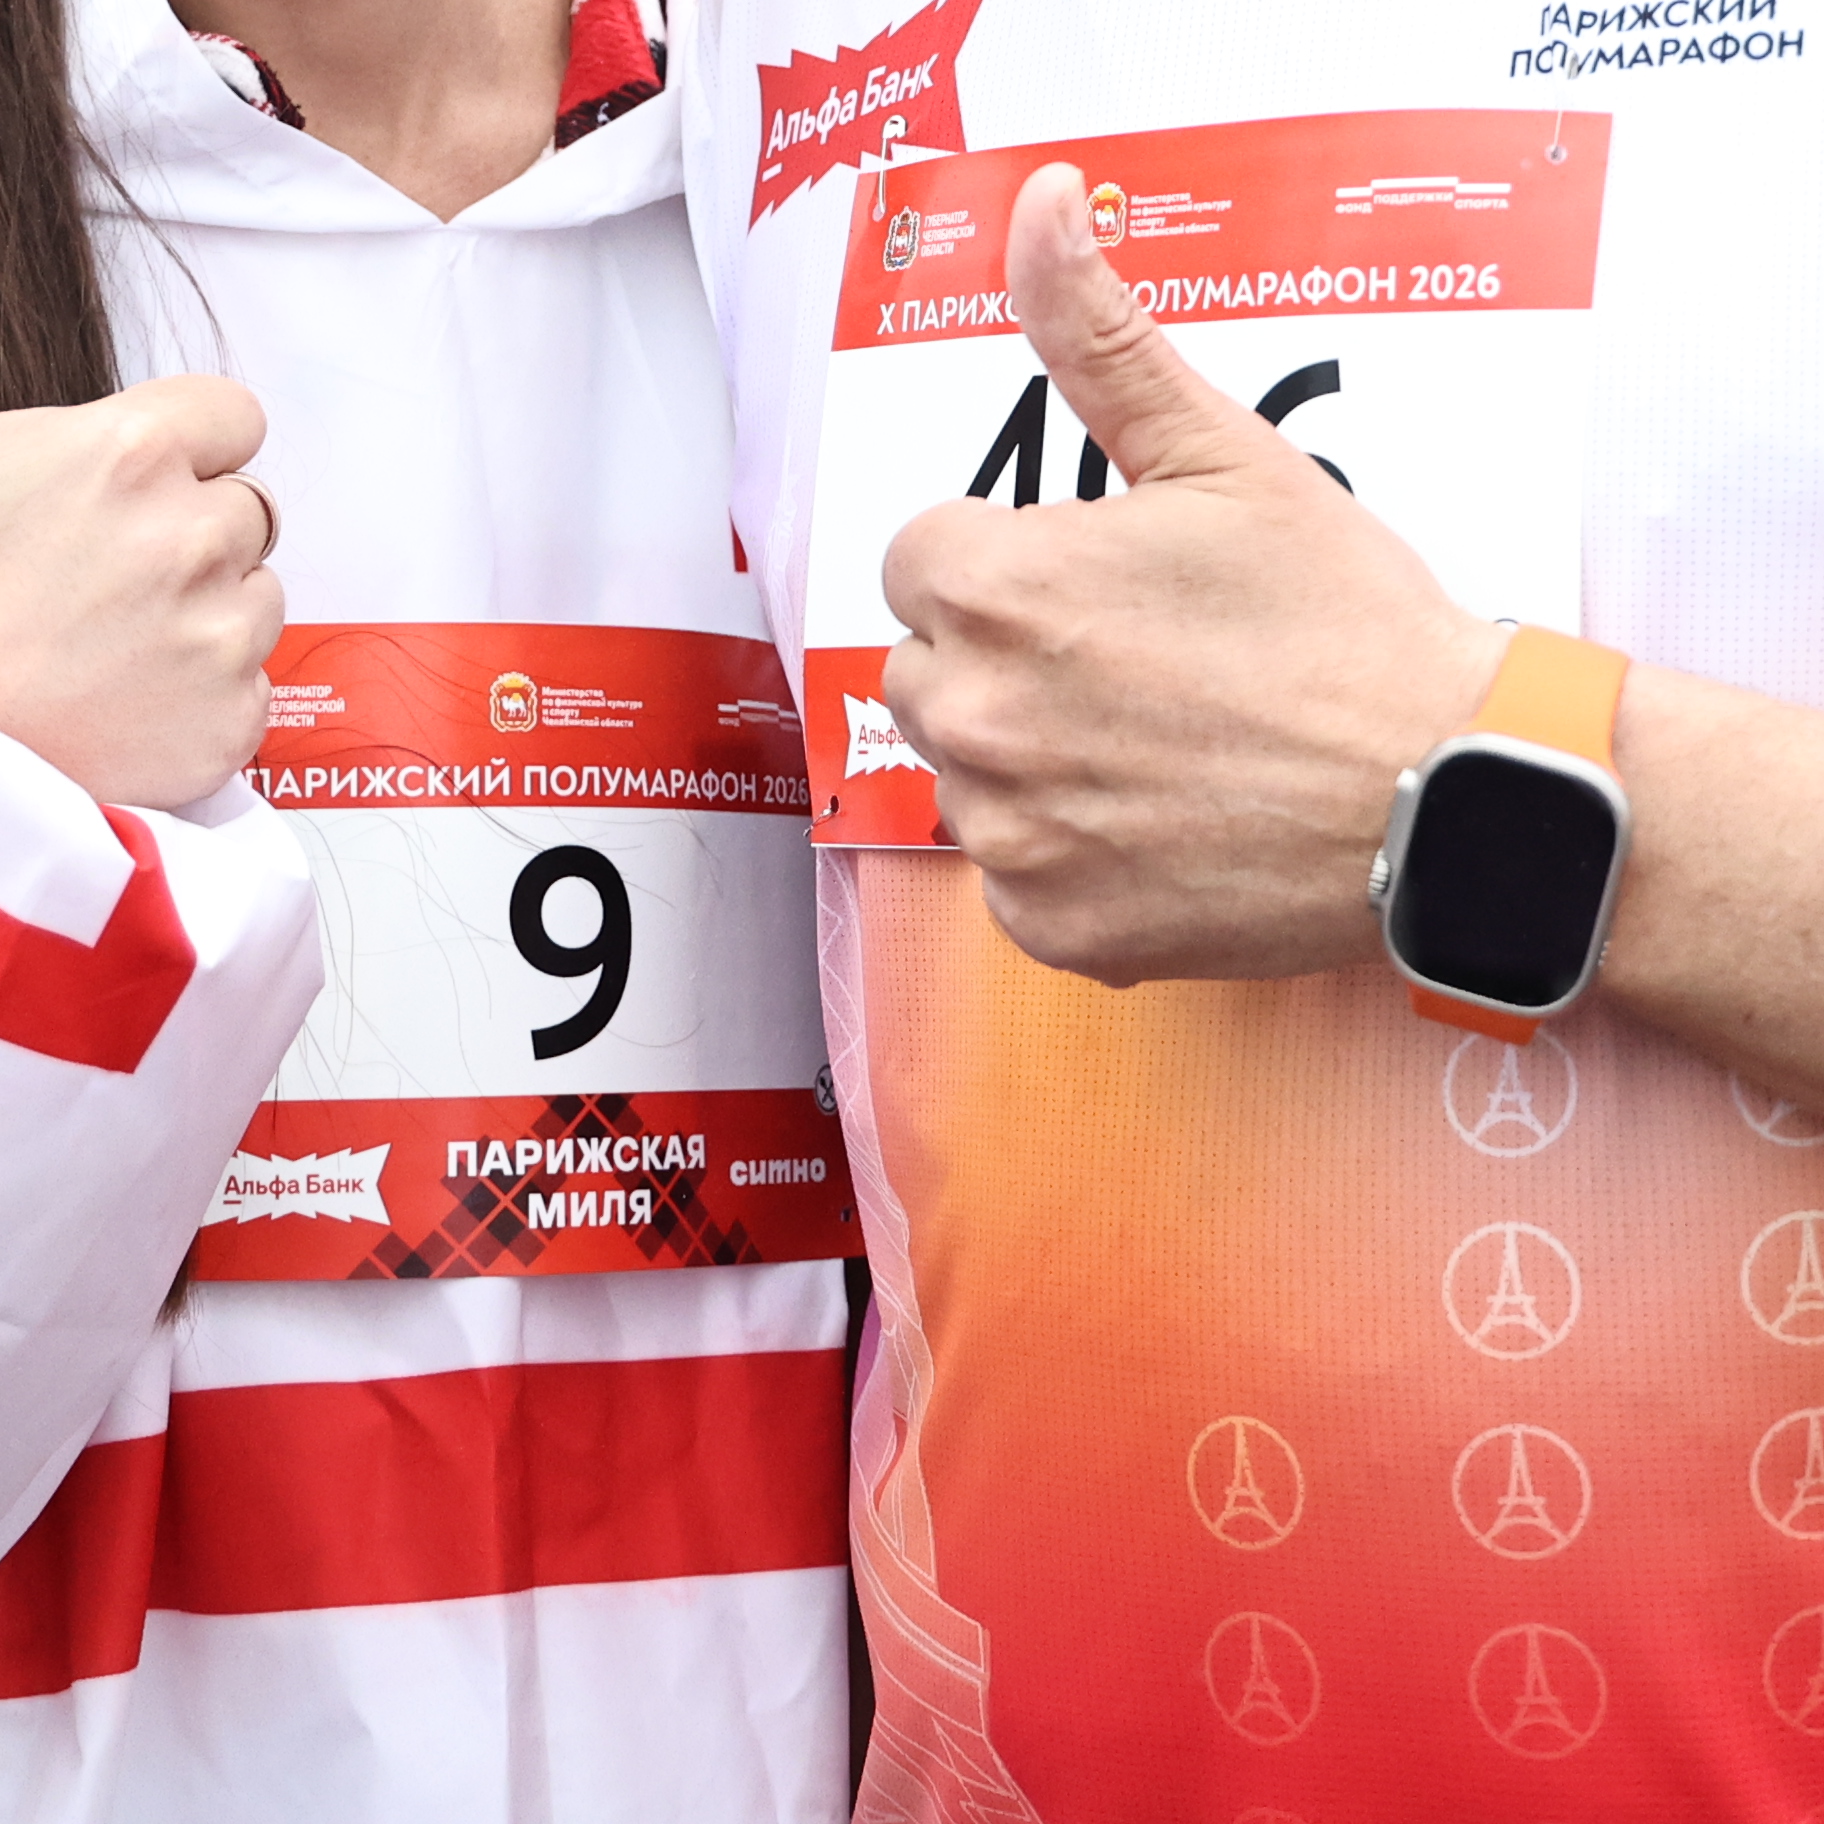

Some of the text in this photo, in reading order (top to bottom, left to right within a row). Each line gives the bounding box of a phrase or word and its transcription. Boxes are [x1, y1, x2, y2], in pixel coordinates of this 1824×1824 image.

[765, 52, 940, 159] Альфа Банк
[924, 210, 969, 228] ГУБЕРНАТОР
[1335, 191, 1509, 214] ФОНД ПОДДЕРЖКИ СПОРТА
[921, 241, 955, 257] ОБЛАСТИ
[922, 221, 976, 243] ЧЕЛЯБИНСКОЙ
[901, 291, 1020, 333] ПАРИЖС
[1124, 264, 1398, 314] ОЛУМАРАФОН
[1407, 264, 1501, 301] 2026
[270, 685, 333, 698] УБЕРНАТОР
[523, 765, 756, 802] ПОЛУМАРАФОН
[763, 775, 808, 804] 2026
[509, 845, 632, 1061] 9
[446, 1134, 706, 1177] ПАРИЖСКАЯ
[223, 1173, 365, 1202] Альфа Банк
[527, 1188, 653, 1229] МИЛЯ
